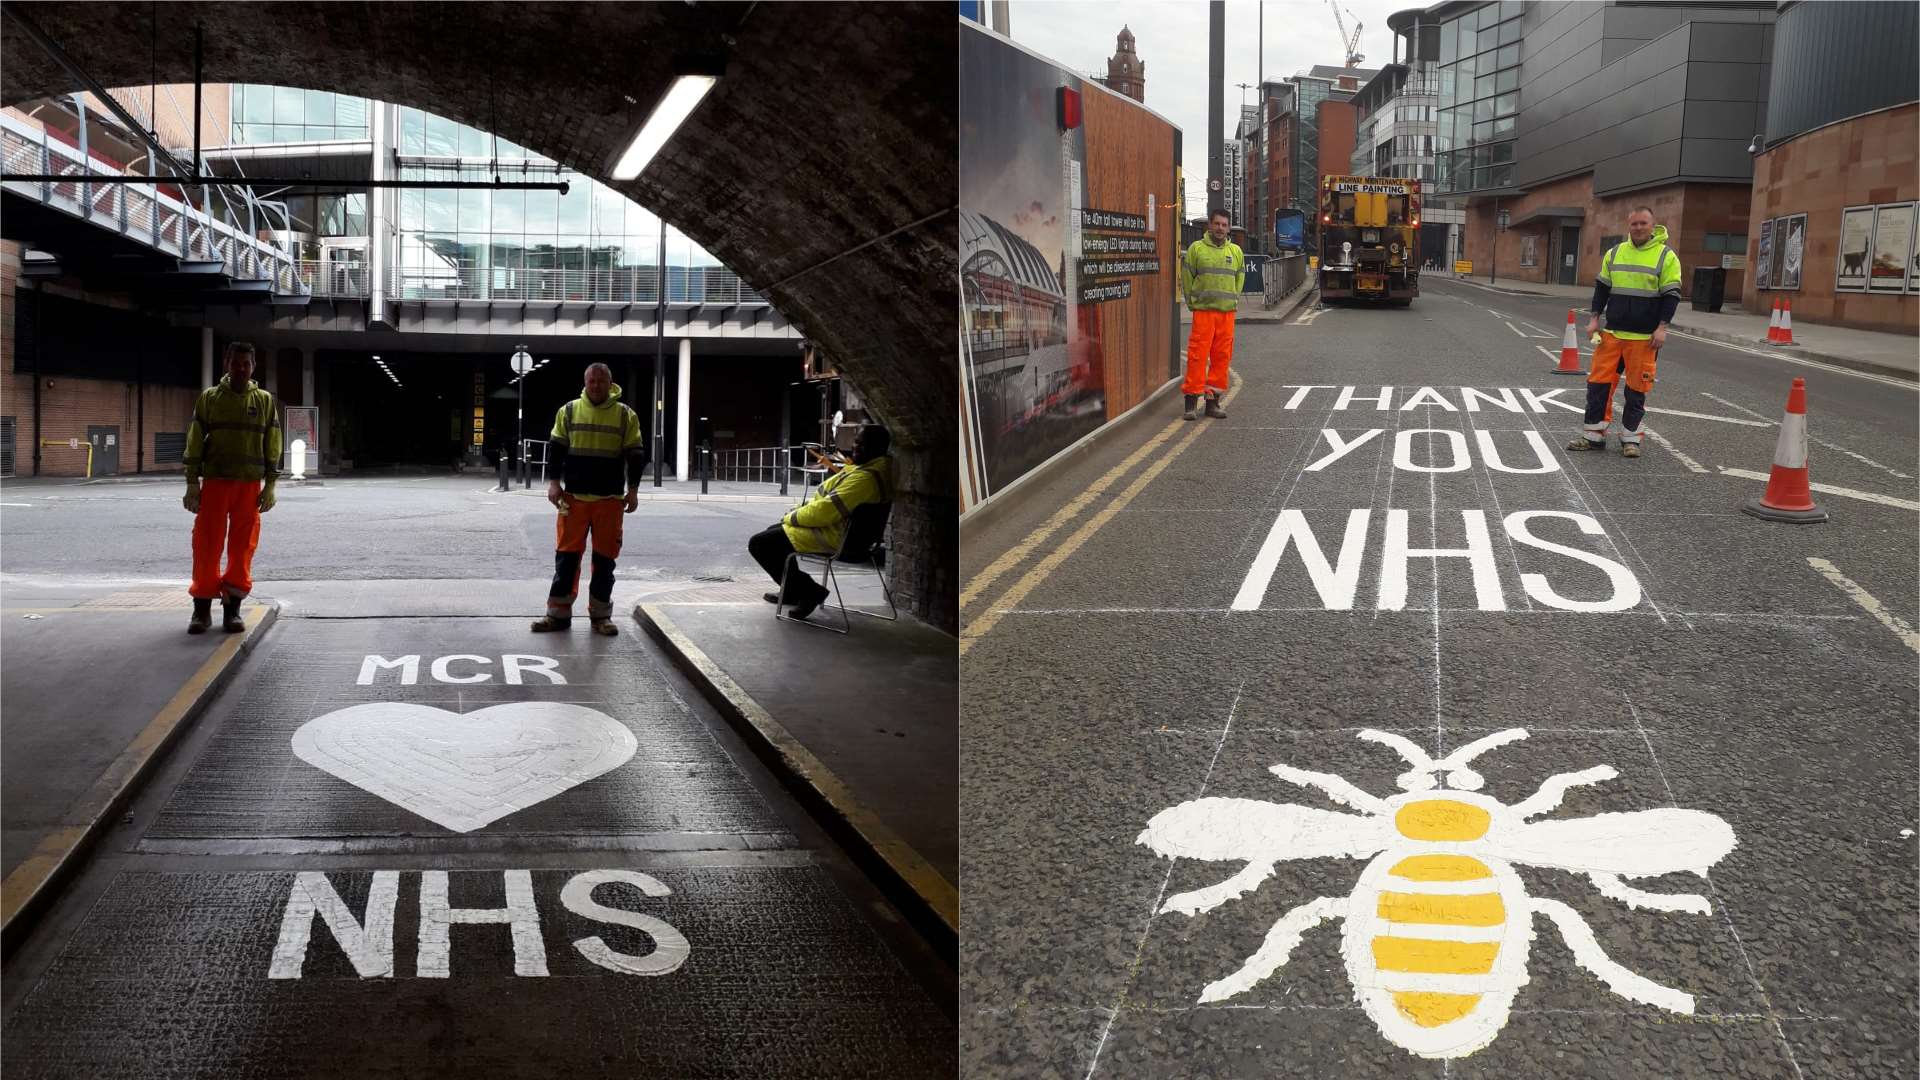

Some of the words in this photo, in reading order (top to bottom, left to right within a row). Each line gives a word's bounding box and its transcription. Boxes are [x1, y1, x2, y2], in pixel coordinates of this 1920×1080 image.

[1338, 184, 1359, 192] LINE
[1362, 185, 1404, 194] PAINTING
[1364, 176, 1404, 186] MAINTENANCE
[1082, 211, 1091, 225] The
[1082, 235, 1109, 252] low-energy
[1109, 237, 1118, 250] LED
[1083, 261, 1098, 275] which
[1106, 261, 1113, 273] be
[1083, 286, 1105, 301] creating
[1105, 284, 1121, 298] moving
[1282, 385, 1586, 413] THANK
[1304, 428, 1561, 474] YOU
[1230, 508, 1641, 612] NHS
[356, 654, 568, 685] MCR
[267, 869, 691, 979] NHS
